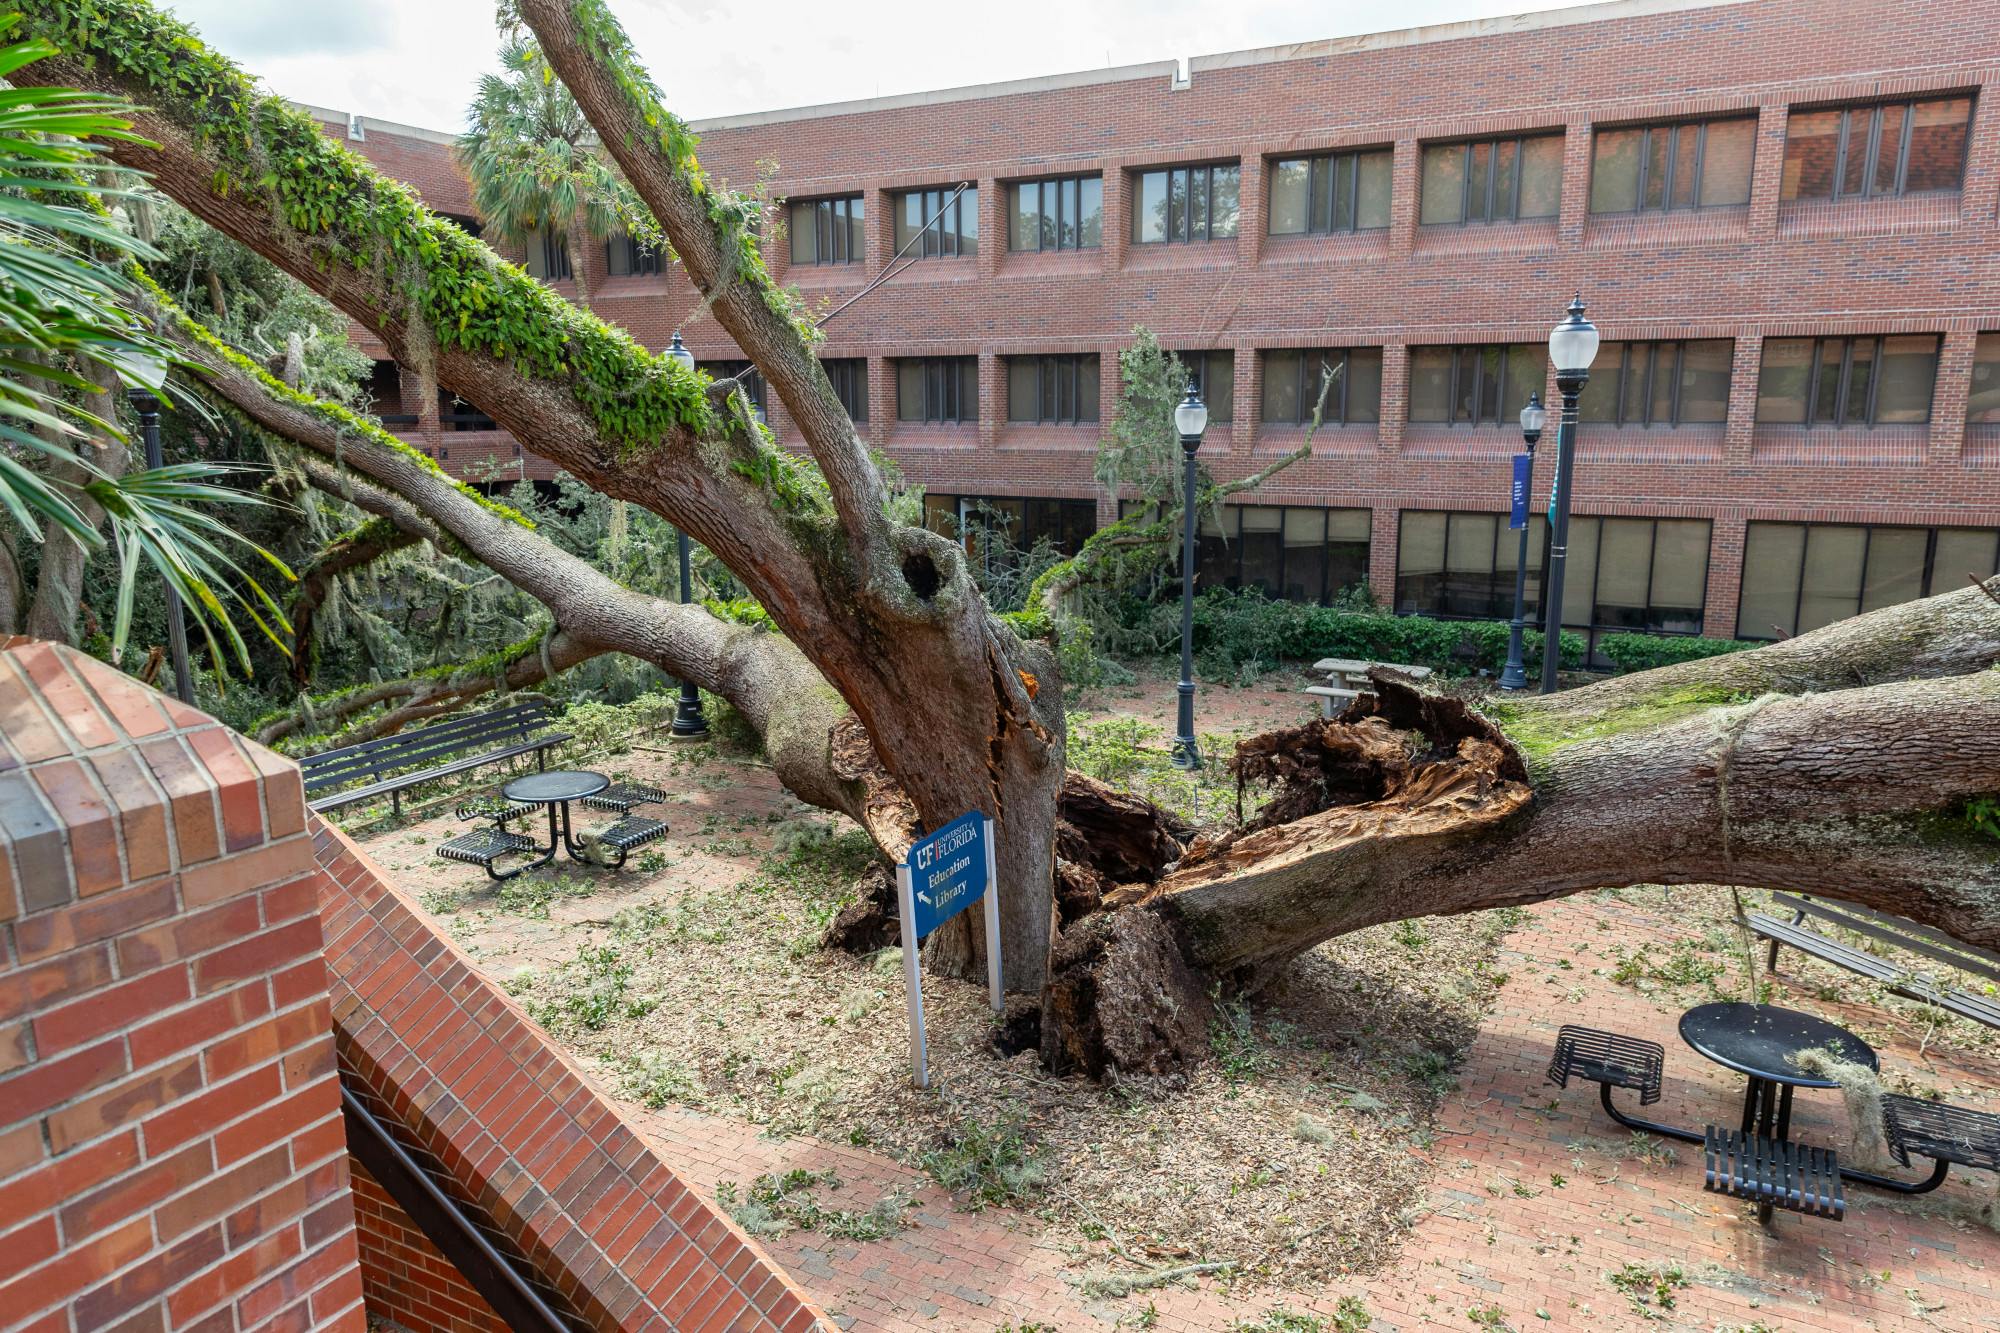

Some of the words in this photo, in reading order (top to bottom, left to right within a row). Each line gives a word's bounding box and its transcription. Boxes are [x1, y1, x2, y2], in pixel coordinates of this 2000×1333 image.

[937, 822, 968, 845] UNIVERSITY
[938, 826, 977, 858] FLORIDA
[917, 843, 934, 869] UF
[928, 856, 970, 888] Education
[935, 880, 967, 908] Library
